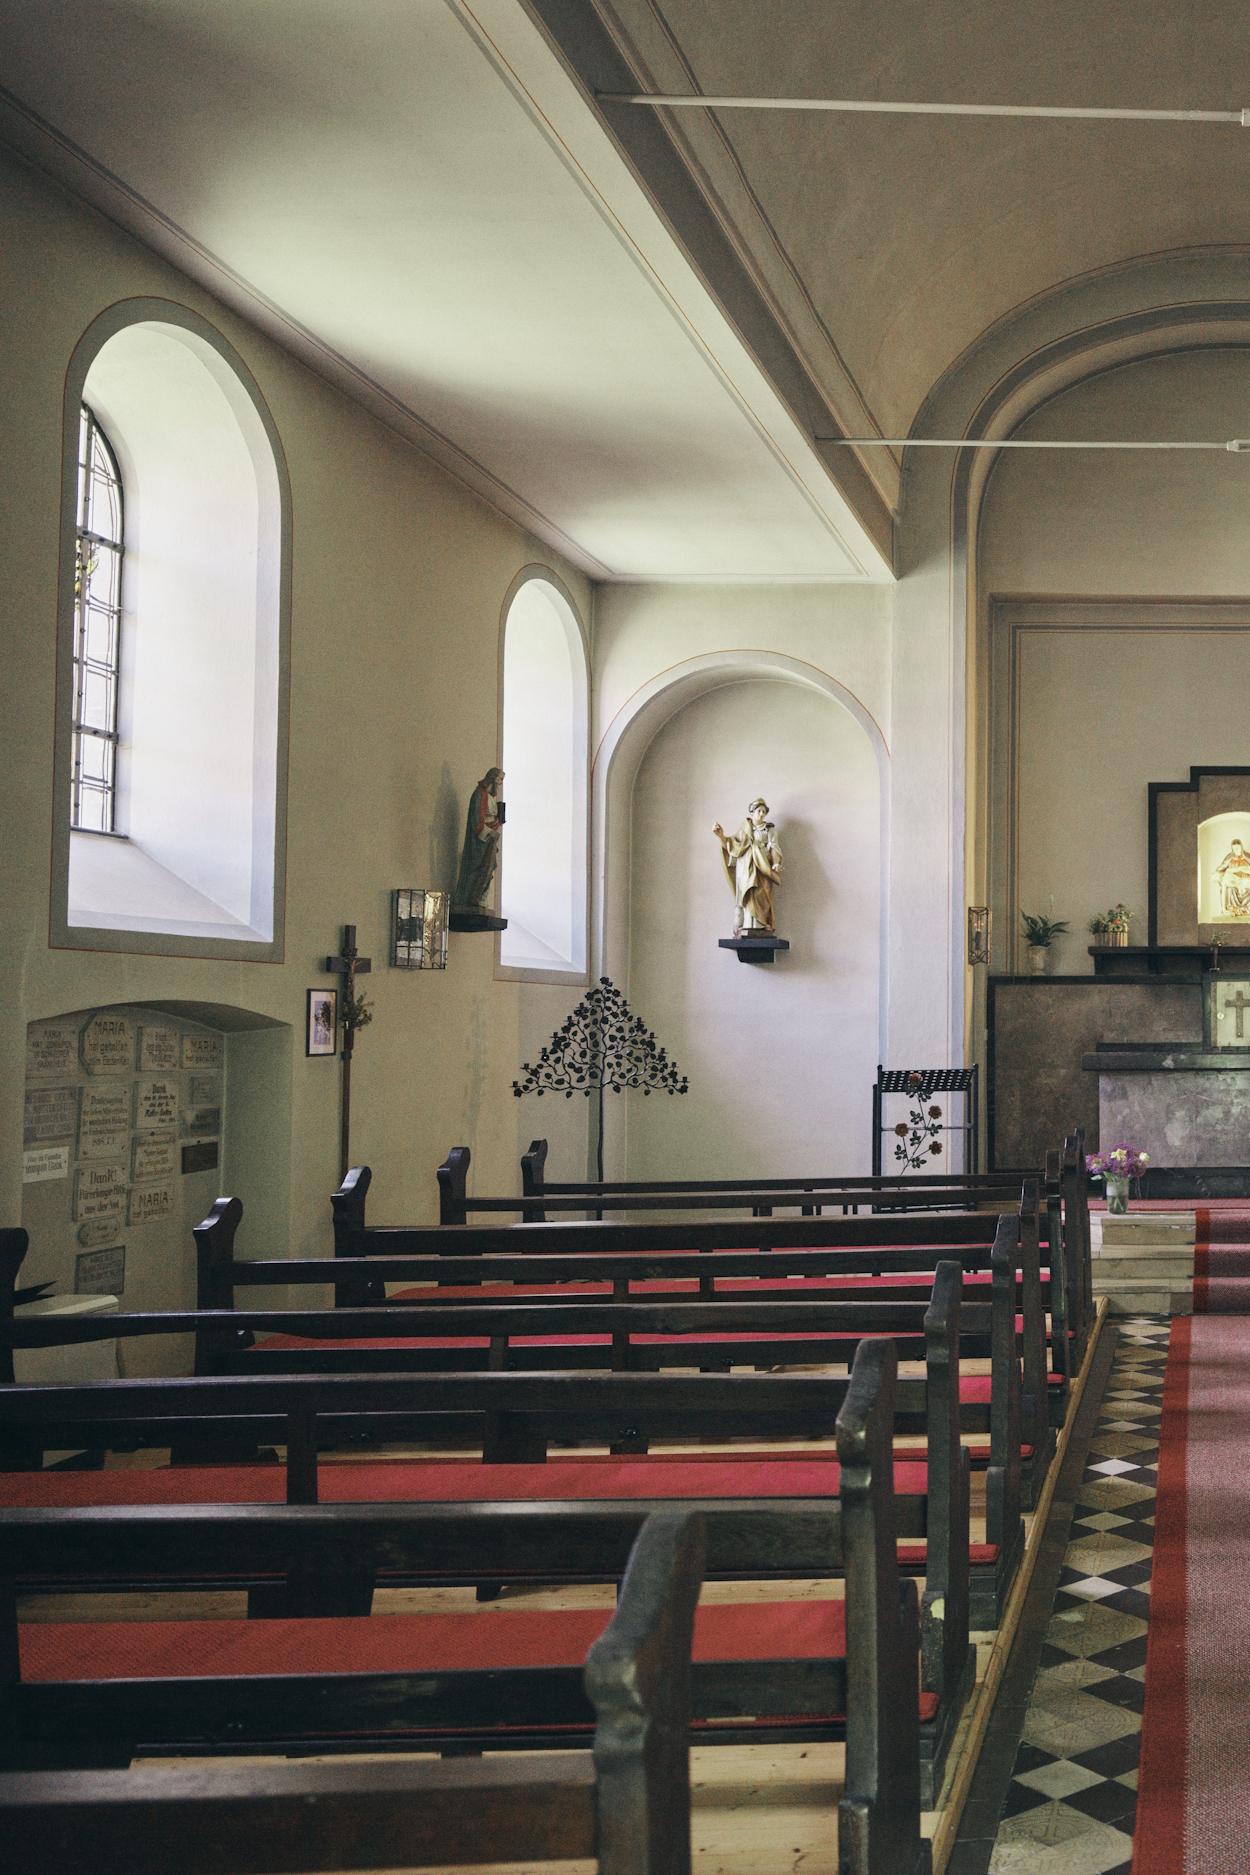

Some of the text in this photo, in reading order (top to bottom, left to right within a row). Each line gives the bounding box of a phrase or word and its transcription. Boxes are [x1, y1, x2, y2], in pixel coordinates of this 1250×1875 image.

[94, 1021, 125, 1035] MARIA
[190, 1040, 217, 1052] MARIA
[138, 1191, 169, 1208] MARIA
